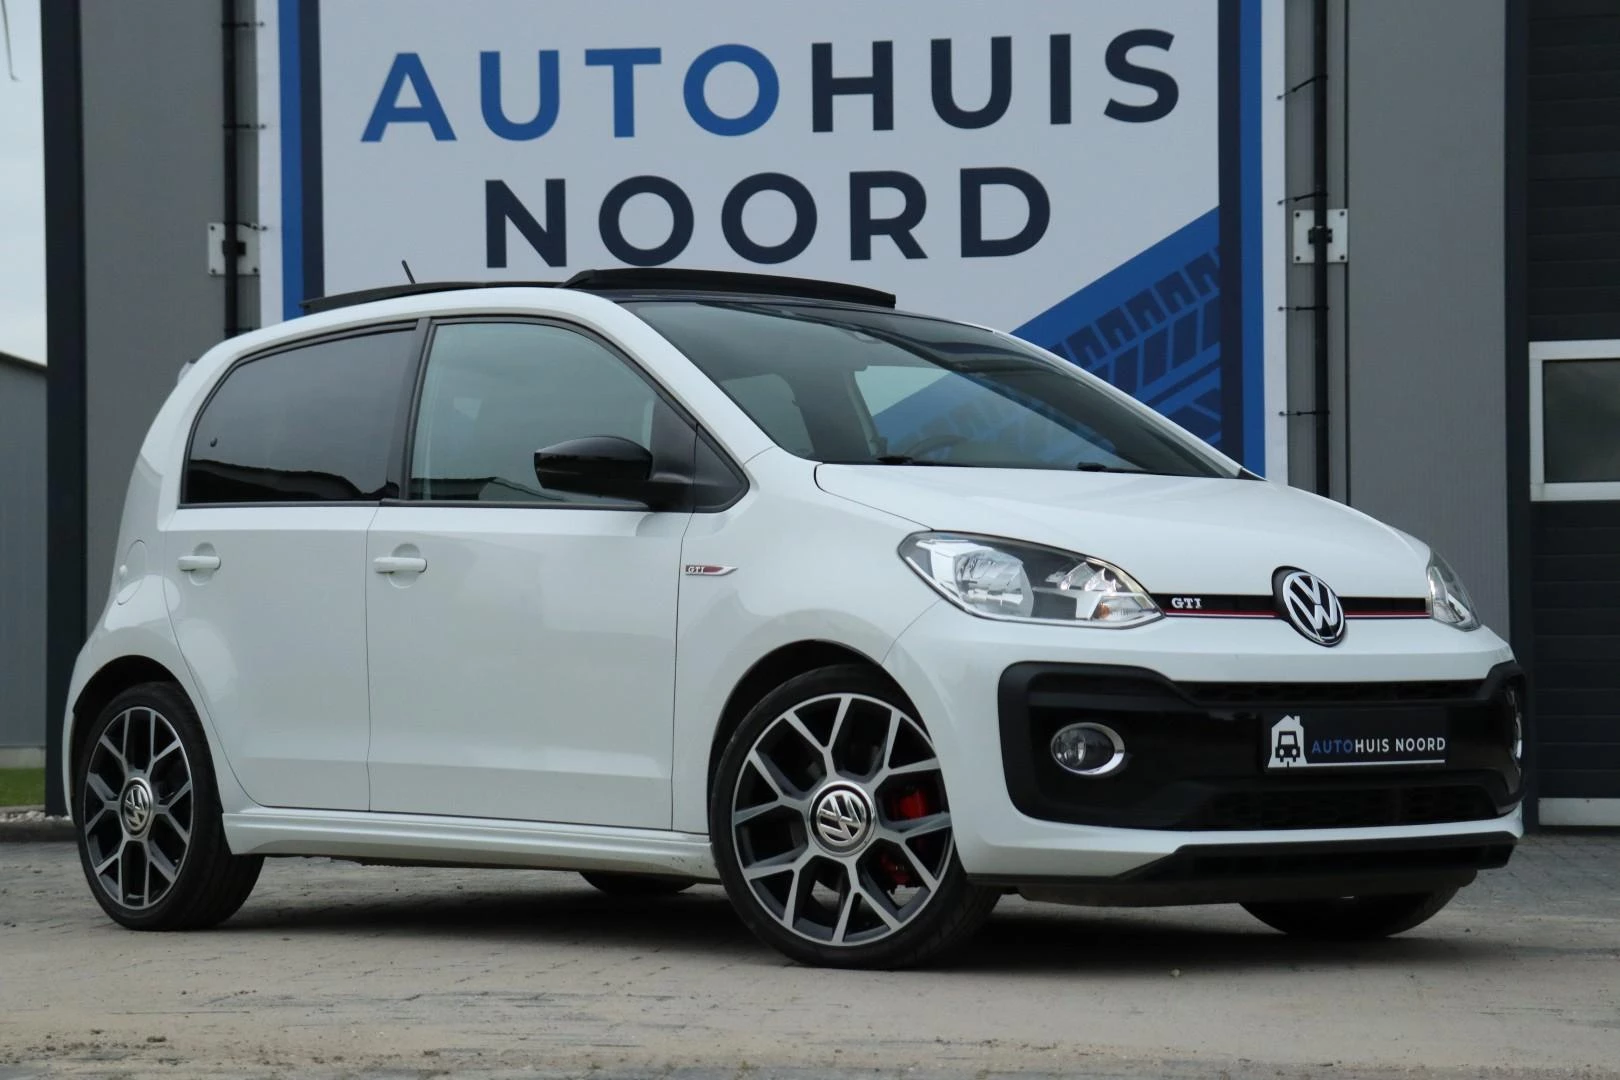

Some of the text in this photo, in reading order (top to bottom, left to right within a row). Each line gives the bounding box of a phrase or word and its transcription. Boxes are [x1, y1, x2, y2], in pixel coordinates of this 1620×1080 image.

[360, 29, 1180, 143] AUTOHUIS
[485, 166, 1051, 269] NOORD
[687, 565, 706, 575] GTI
[1171, 596, 1203, 610] GTI
[1311, 737, 1446, 754] AUTOHUIS NOORD
